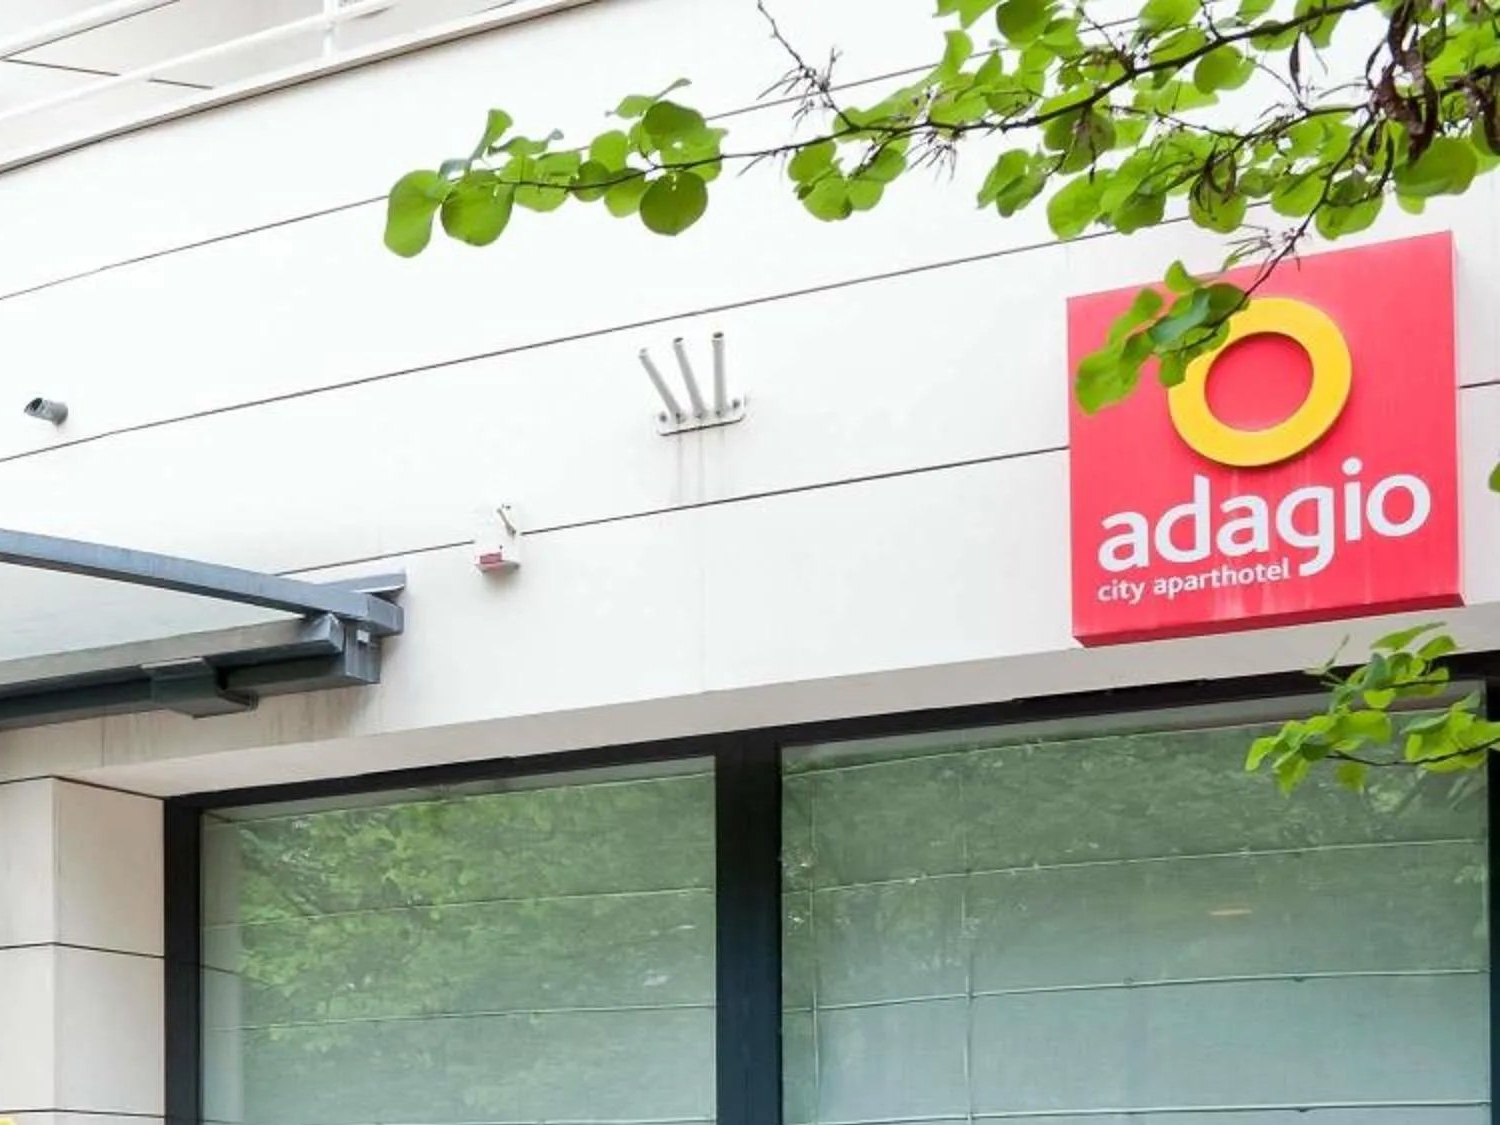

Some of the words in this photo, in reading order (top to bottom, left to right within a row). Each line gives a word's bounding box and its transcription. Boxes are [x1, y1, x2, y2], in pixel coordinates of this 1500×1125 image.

[1099, 457, 1431, 576] adagio
[1098, 579, 1145, 605] city
[1153, 557, 1290, 600] aparthotel
